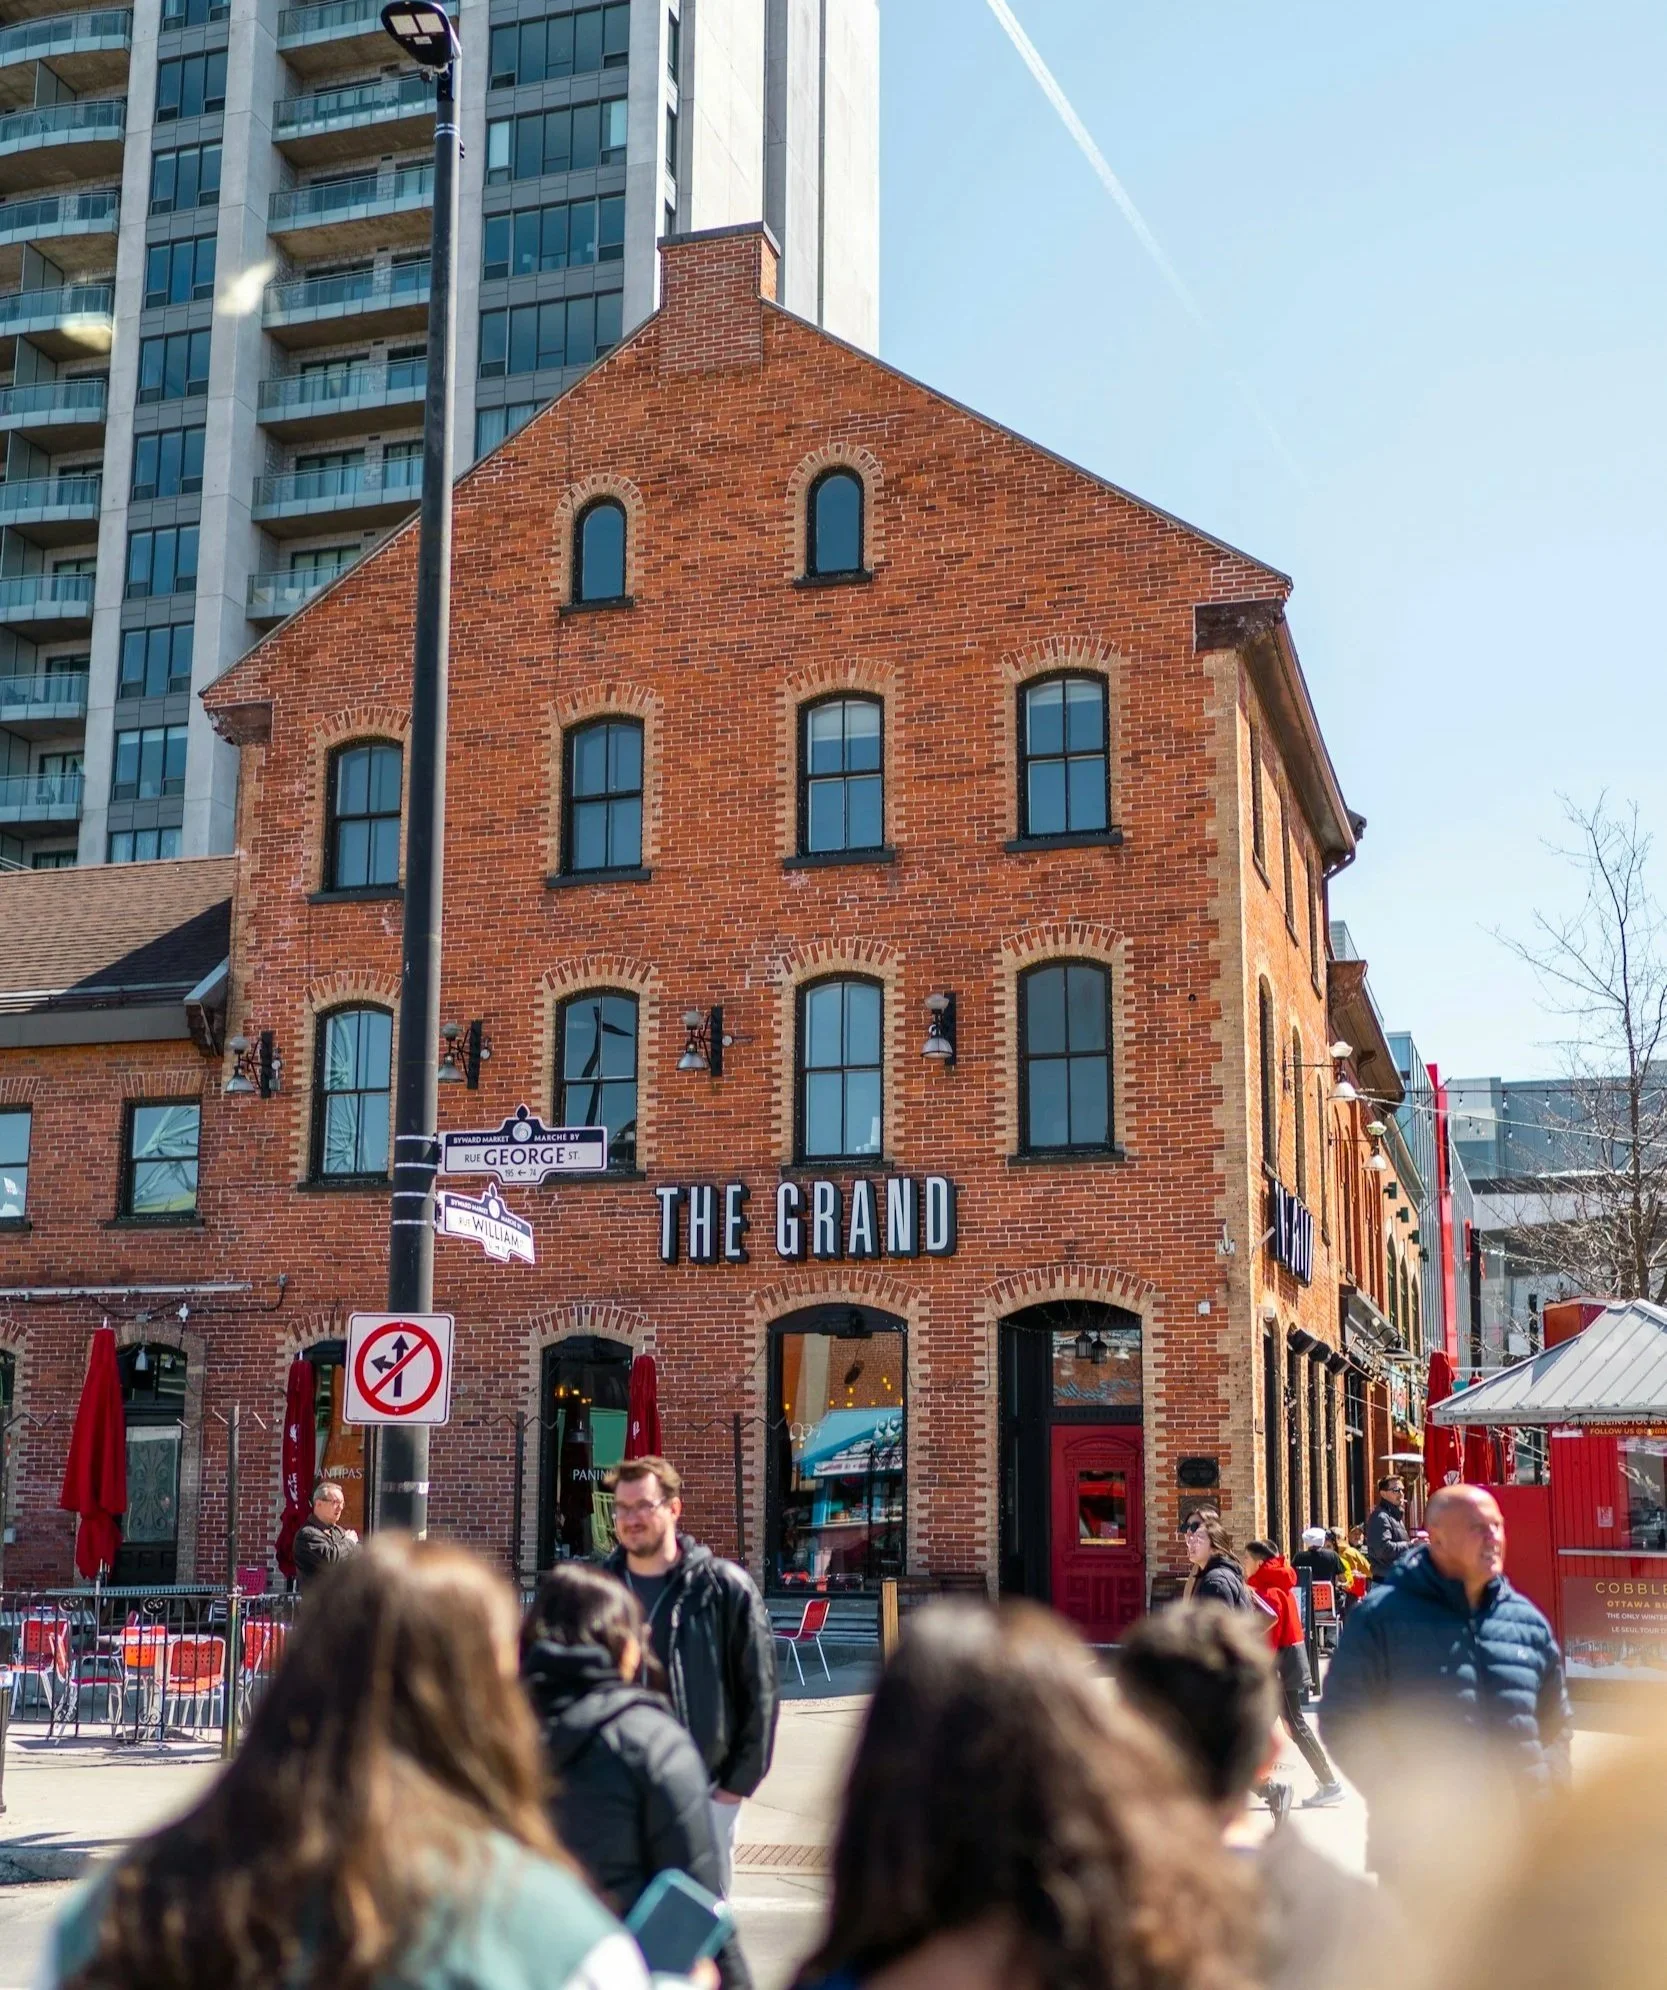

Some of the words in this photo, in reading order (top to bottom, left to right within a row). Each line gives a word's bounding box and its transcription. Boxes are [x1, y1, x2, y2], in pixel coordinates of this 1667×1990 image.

[453, 1136, 481, 1144] BYWARD
[482, 1135, 509, 1143] MARKET
[534, 1132, 567, 1142] MARCHÉ
[570, 1133, 580, 1141] BY
[464, 1154, 481, 1163] RUE
[484, 1147, 565, 1166] GEORGE
[504, 1169, 514, 1177] 195
[529, 1168, 537, 1177] 74
[655, 1184, 748, 1264] THE
[776, 1175, 956, 1260] GRAND
[472, 1216, 520, 1249] WILLIAM
[316, 1467, 364, 1479] ANTIPAS
[1607, 1600, 1650, 1608] OTTAWA
